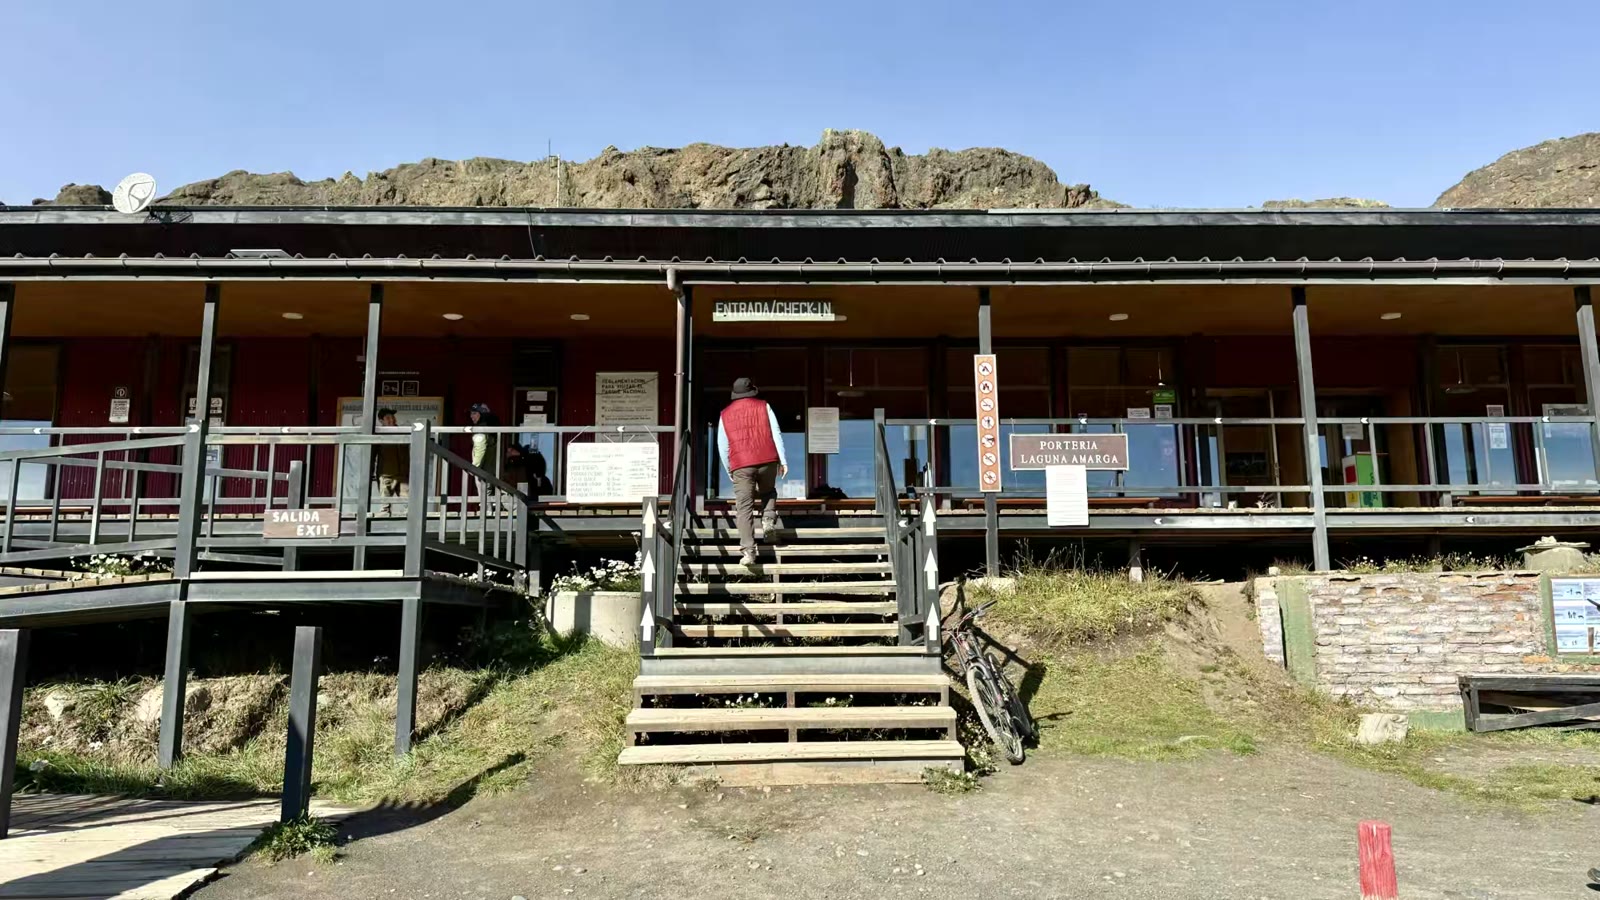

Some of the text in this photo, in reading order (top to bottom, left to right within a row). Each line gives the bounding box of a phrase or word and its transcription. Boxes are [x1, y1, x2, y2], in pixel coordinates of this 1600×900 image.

[715, 300, 831, 316] ENTRADA/CHECK-IN
[1040, 441, 1098, 450] PORTERIA
[1020, 454, 1119, 464] LAGUNA AMARGA
[272, 511, 320, 523] SALIDA
[296, 524, 330, 537] EXIT
